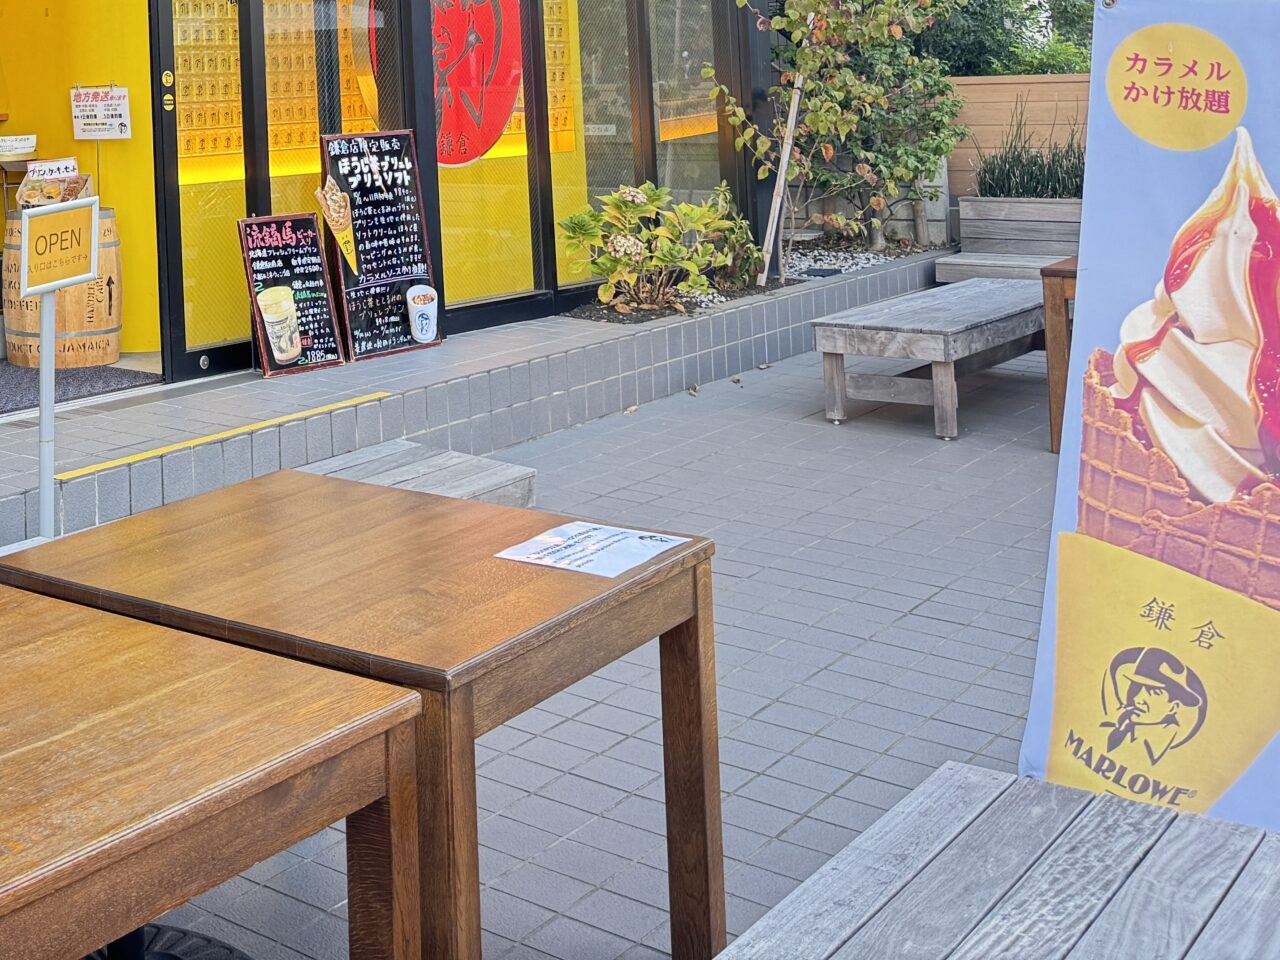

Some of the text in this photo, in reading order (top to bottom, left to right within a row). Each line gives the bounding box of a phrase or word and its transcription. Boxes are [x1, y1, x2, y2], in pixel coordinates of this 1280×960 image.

[1125, 52, 1232, 82] カラメル
[1123, 81, 1232, 115] かけ放題
[439, 131, 470, 157] 鎌倉
[34, 227, 82, 256] OPEN
[246, 221, 297, 249] 流鏑馬
[1139, 596, 1226, 651] 鎌倉
[1064, 728, 1190, 807] MARLOWE
